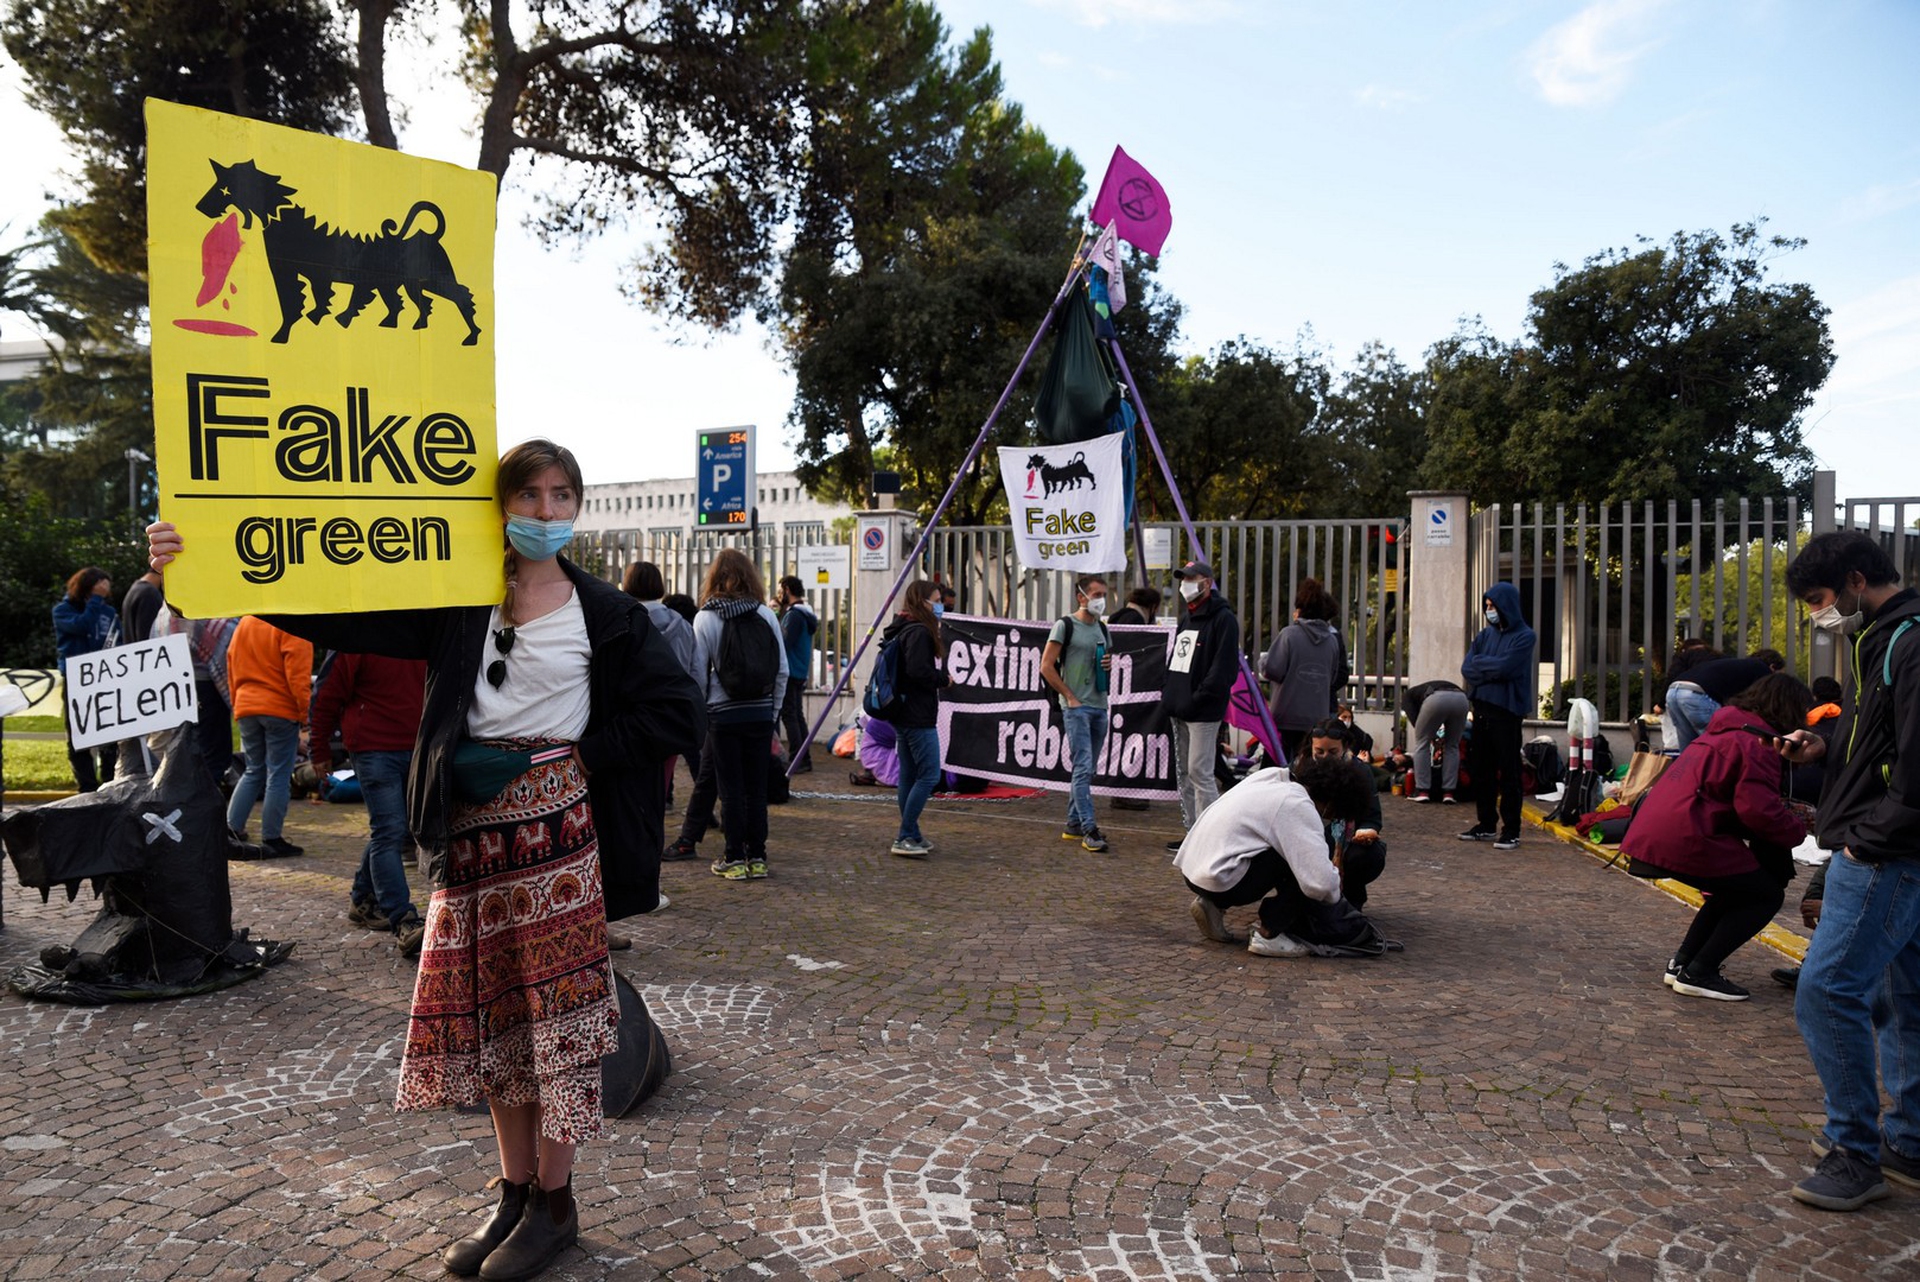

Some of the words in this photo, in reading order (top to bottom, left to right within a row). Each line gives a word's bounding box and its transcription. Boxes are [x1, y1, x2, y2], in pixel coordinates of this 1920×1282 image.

[186, 373, 477, 485] Fake
[729, 433, 747, 444] 254
[714, 452, 742, 460] America
[713, 464, 732, 493] P
[721, 502, 742, 510] Africa
[729, 512, 746, 523] 170
[1025, 507, 1096, 535] Fake
[235, 516, 451, 584] green
[1038, 540, 1090, 560] green
[80, 645, 172, 687] BASTA
[947, 628, 1133, 698] extinn
[72, 671, 192, 735] VELeni
